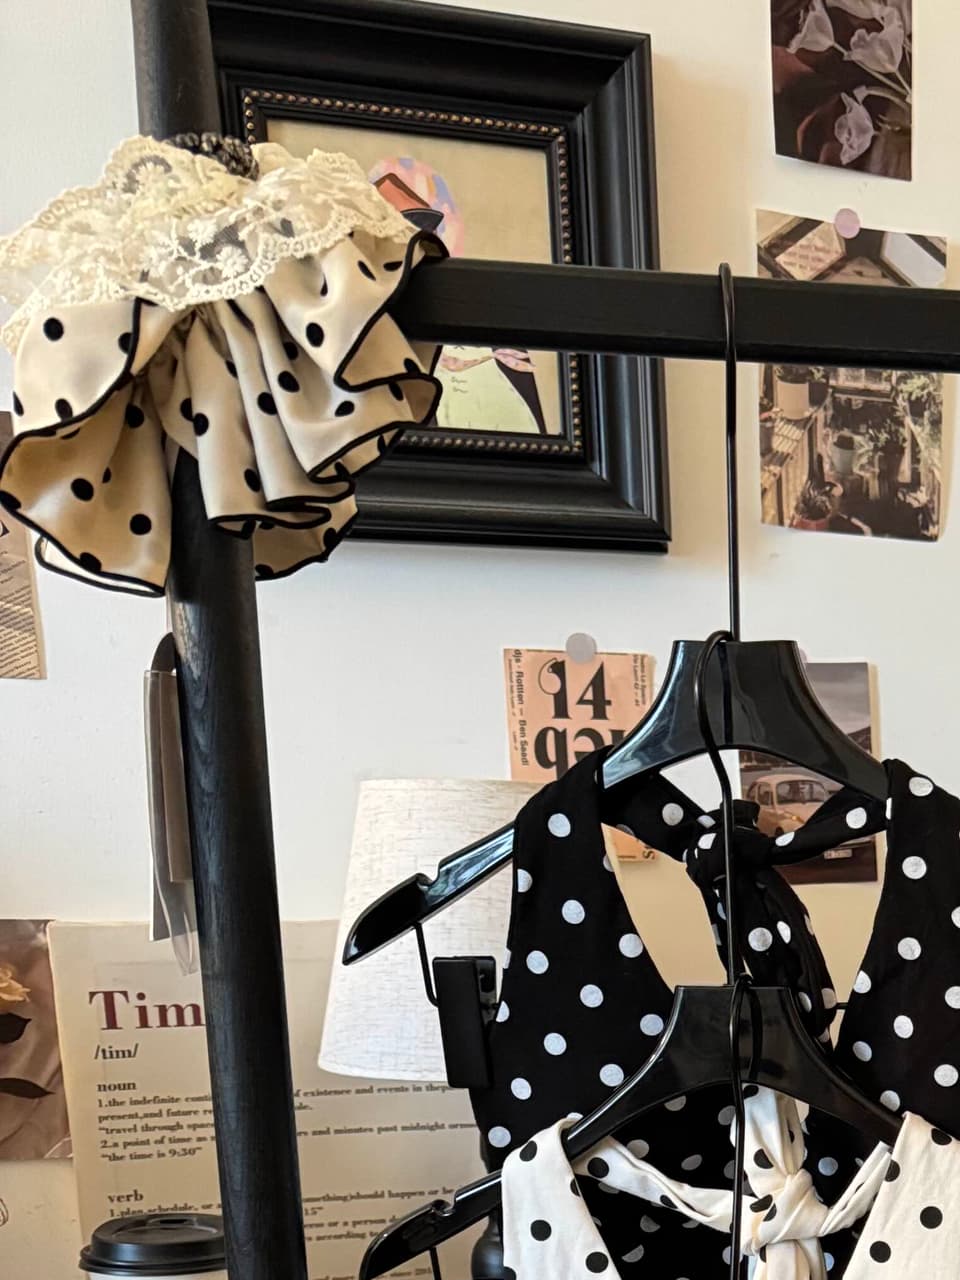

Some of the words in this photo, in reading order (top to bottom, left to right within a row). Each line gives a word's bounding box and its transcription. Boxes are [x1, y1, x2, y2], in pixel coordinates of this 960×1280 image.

[538, 657, 613, 721] 14
[88, 990, 206, 1030] Tim
[94, 1043, 139, 1060] /tim/
[97, 1081, 136, 1092] noun
[303, 1088, 352, 1098] existence
[355, 1085, 374, 1095] and
[377, 1086, 410, 1095] events
[412, 1084, 423, 1093] in
[129, 1095, 181, 1106] indefinite
[166, 1108, 200, 1118] future
[141, 1121, 184, 1133] through
[312, 1127, 331, 1137] and
[334, 1125, 374, 1136] minutes
[377, 1124, 398, 1135] past
[401, 1121, 446, 1133] midnight
[123, 1138, 151, 1150] point
[154, 1135, 166, 1145] of
[168, 1135, 193, 1145] time
[129, 1151, 153, 1161] time
[157, 1150, 166, 1159] is
[107, 1188, 144, 1203] verb
[388, 1189, 425, 1200] happen
[428, 1188, 439, 1196] or
[328, 1220, 339, 1228] or
[352, 1217, 386, 1229] person
[316, 1231, 366, 1242] according
